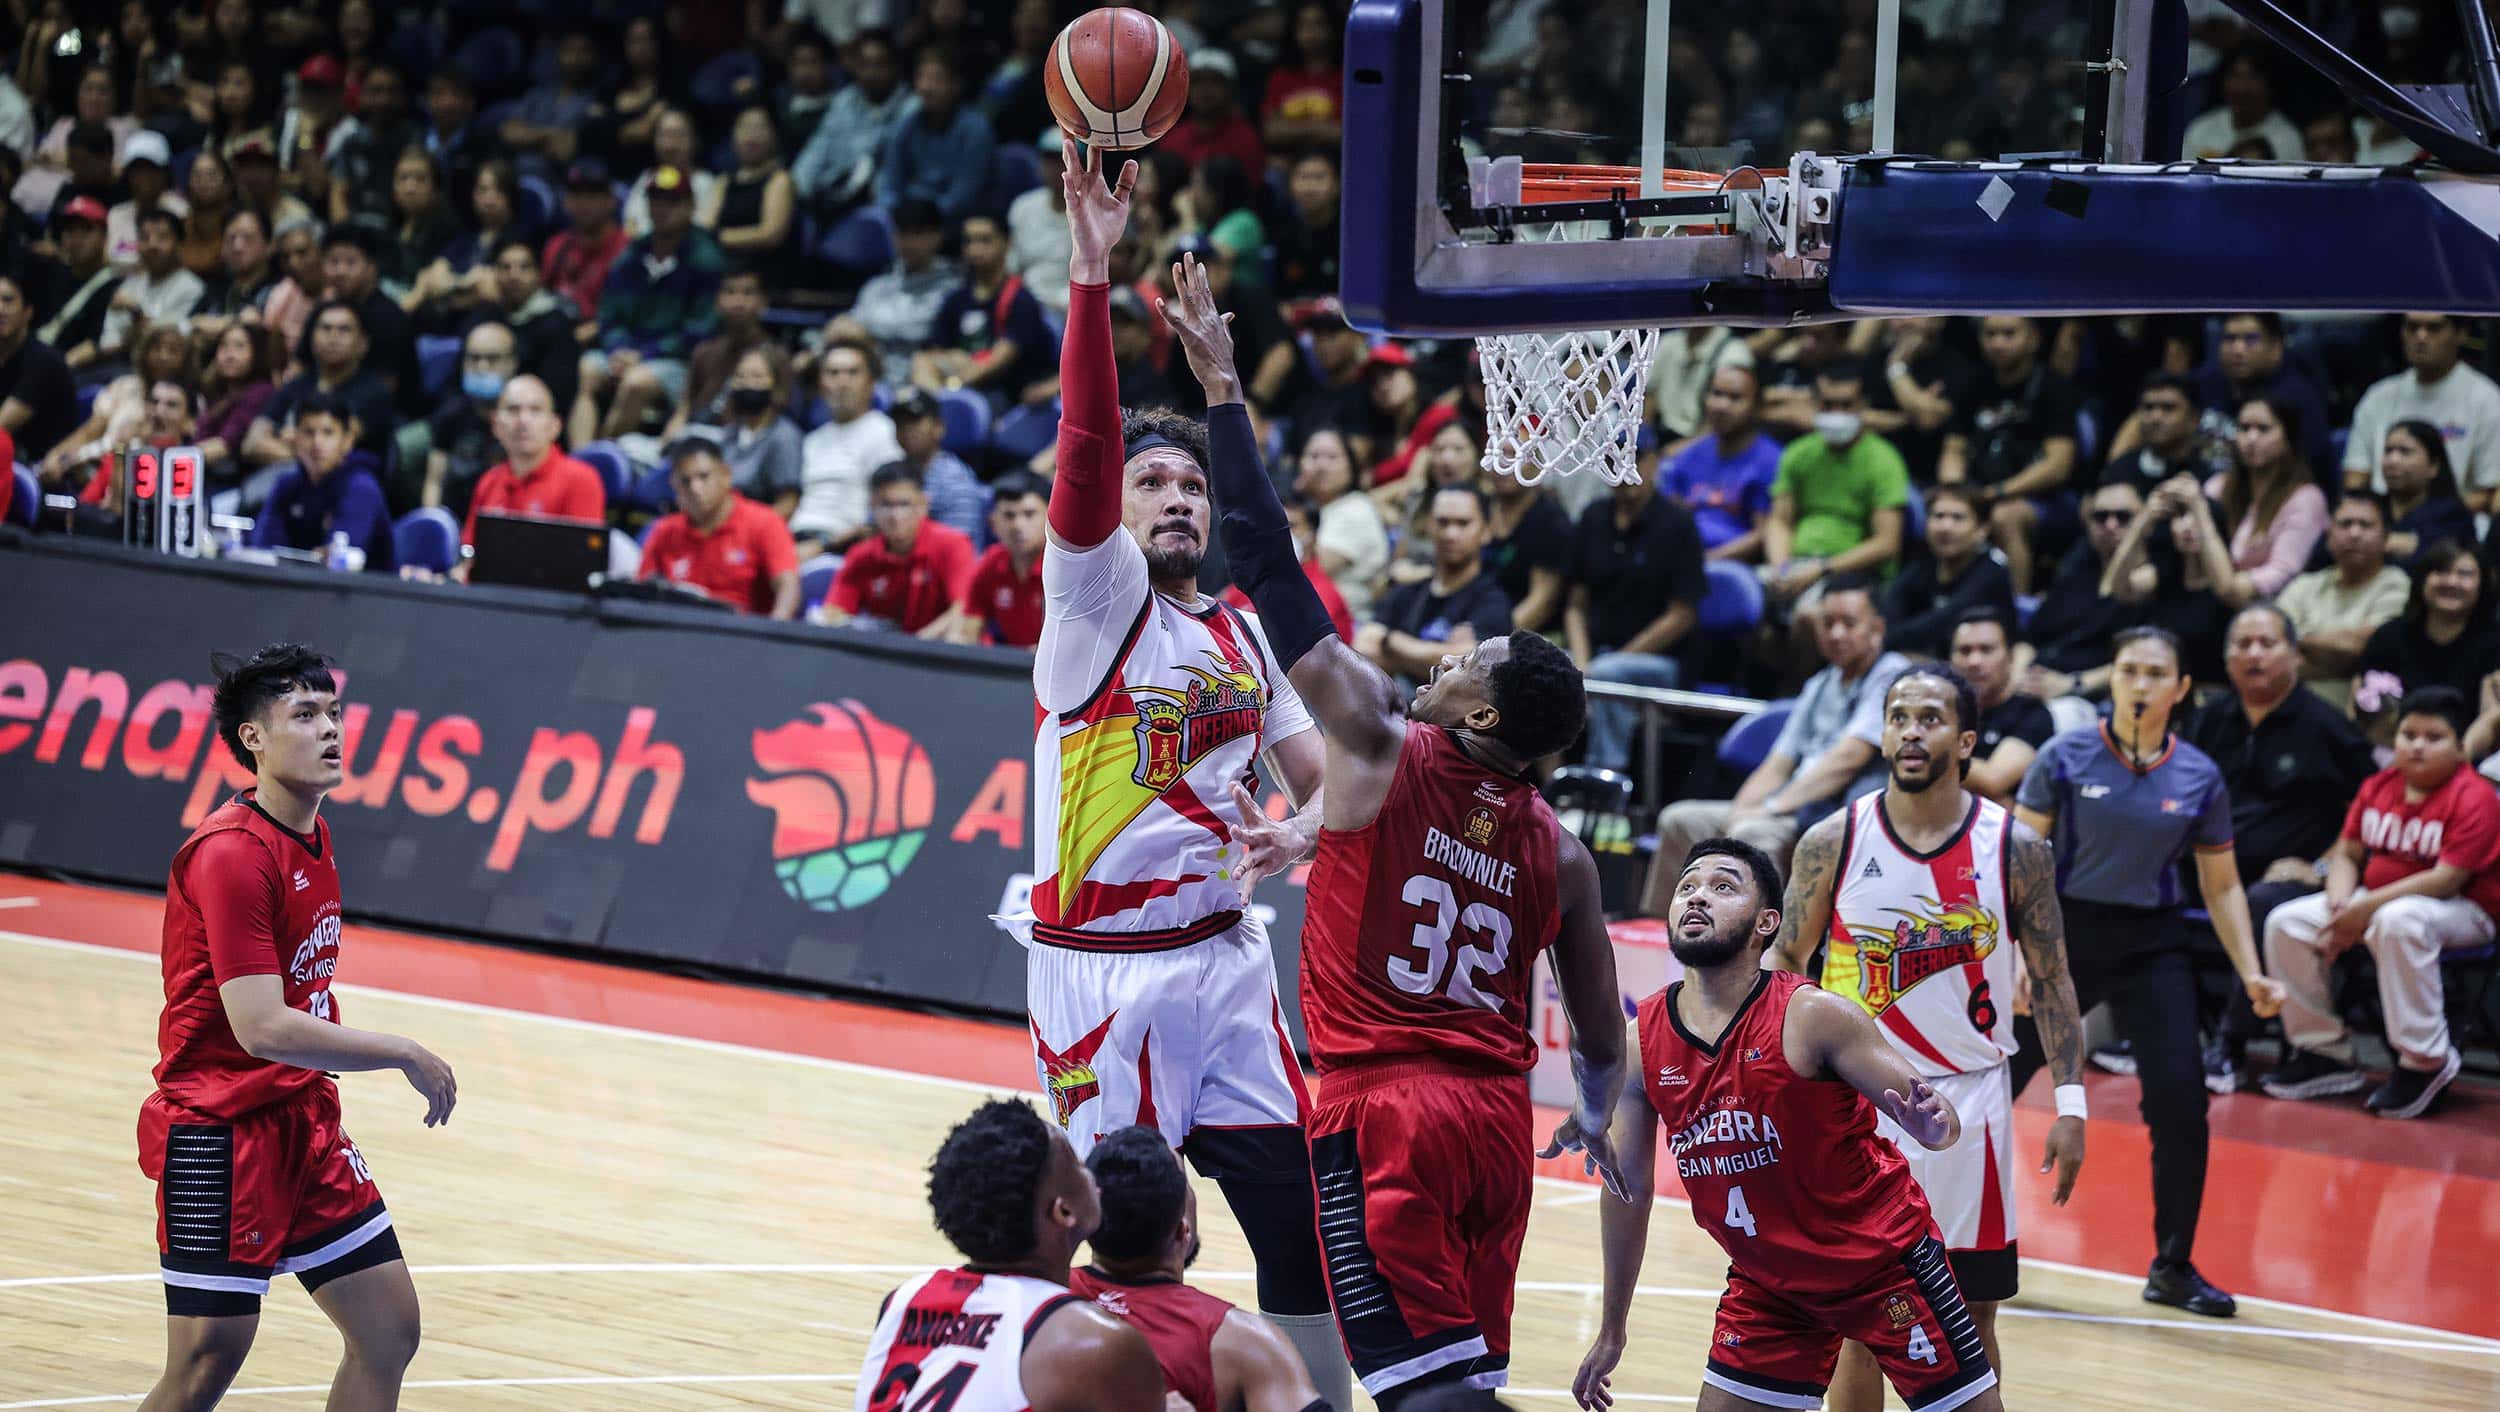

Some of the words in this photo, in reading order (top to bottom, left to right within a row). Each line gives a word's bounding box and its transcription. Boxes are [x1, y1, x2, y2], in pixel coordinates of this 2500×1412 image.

[1190, 708, 1261, 760] BEERME
[1471, 815, 1493, 832] 190
[1423, 826, 1517, 897] BROWNLEE
[289, 915, 341, 974] GINEBR
[1386, 874, 1513, 1014] 32
[1967, 979, 1997, 1033] 6
[1669, 1109, 1783, 1158] GINEBRA
[1686, 1096, 1746, 1122] BARANGAY
[1678, 1158, 1712, 1179] SAN
[1715, 1145, 1779, 1176] MIGUEL
[1725, 1186, 1758, 1238] 4
[1888, 1300, 1909, 1318] 190
[1908, 1323, 1938, 1366] 4
